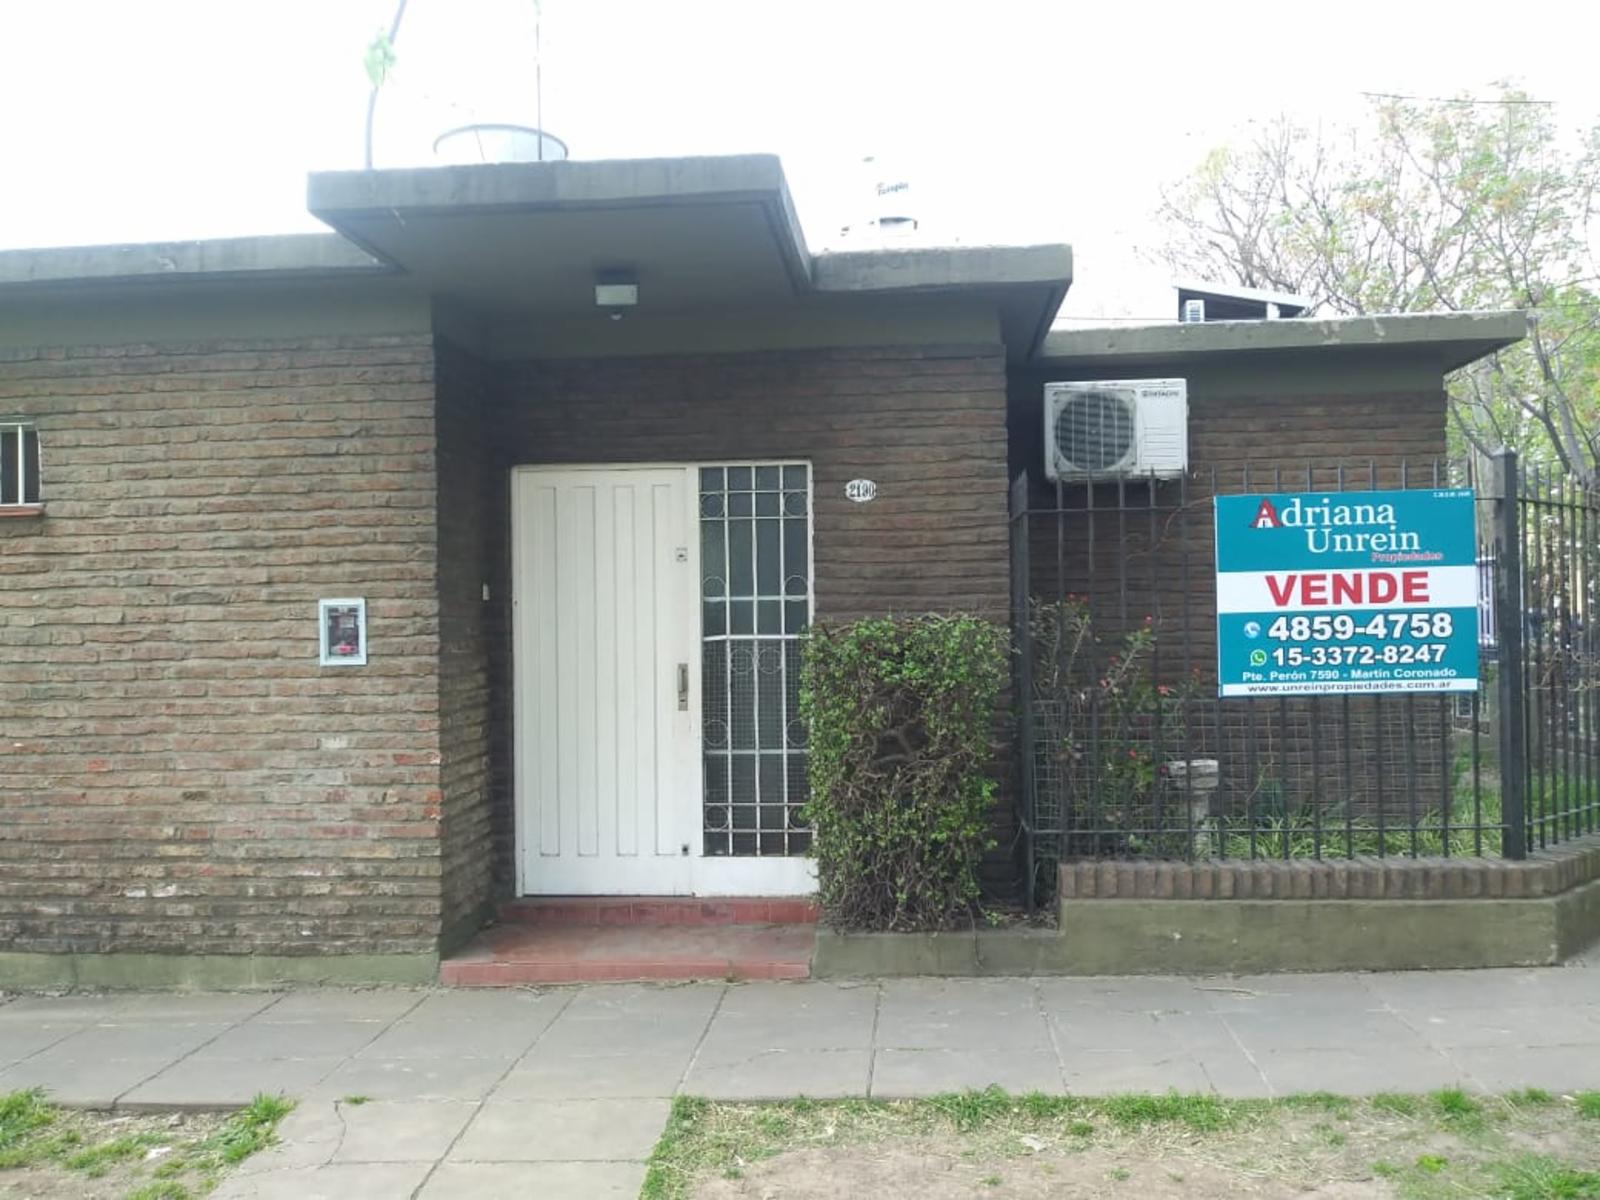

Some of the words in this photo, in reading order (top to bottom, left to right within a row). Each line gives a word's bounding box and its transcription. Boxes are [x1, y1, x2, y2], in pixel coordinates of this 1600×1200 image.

[1250, 498, 1397, 528] Adriana
[1305, 526, 1421, 553] Unrein
[1265, 571, 1430, 607] VENDE
[1267, 613, 1453, 641] 4859-4758
[1272, 644, 1447, 667] 15-3372-8247
[1242, 671, 1267, 682] Pte.
[1270, 670, 1307, 681] Perón
[1393, 667, 1457, 678] Coronado
[1248, 681, 1452, 692] www.unreinpropiedades.com.ar
